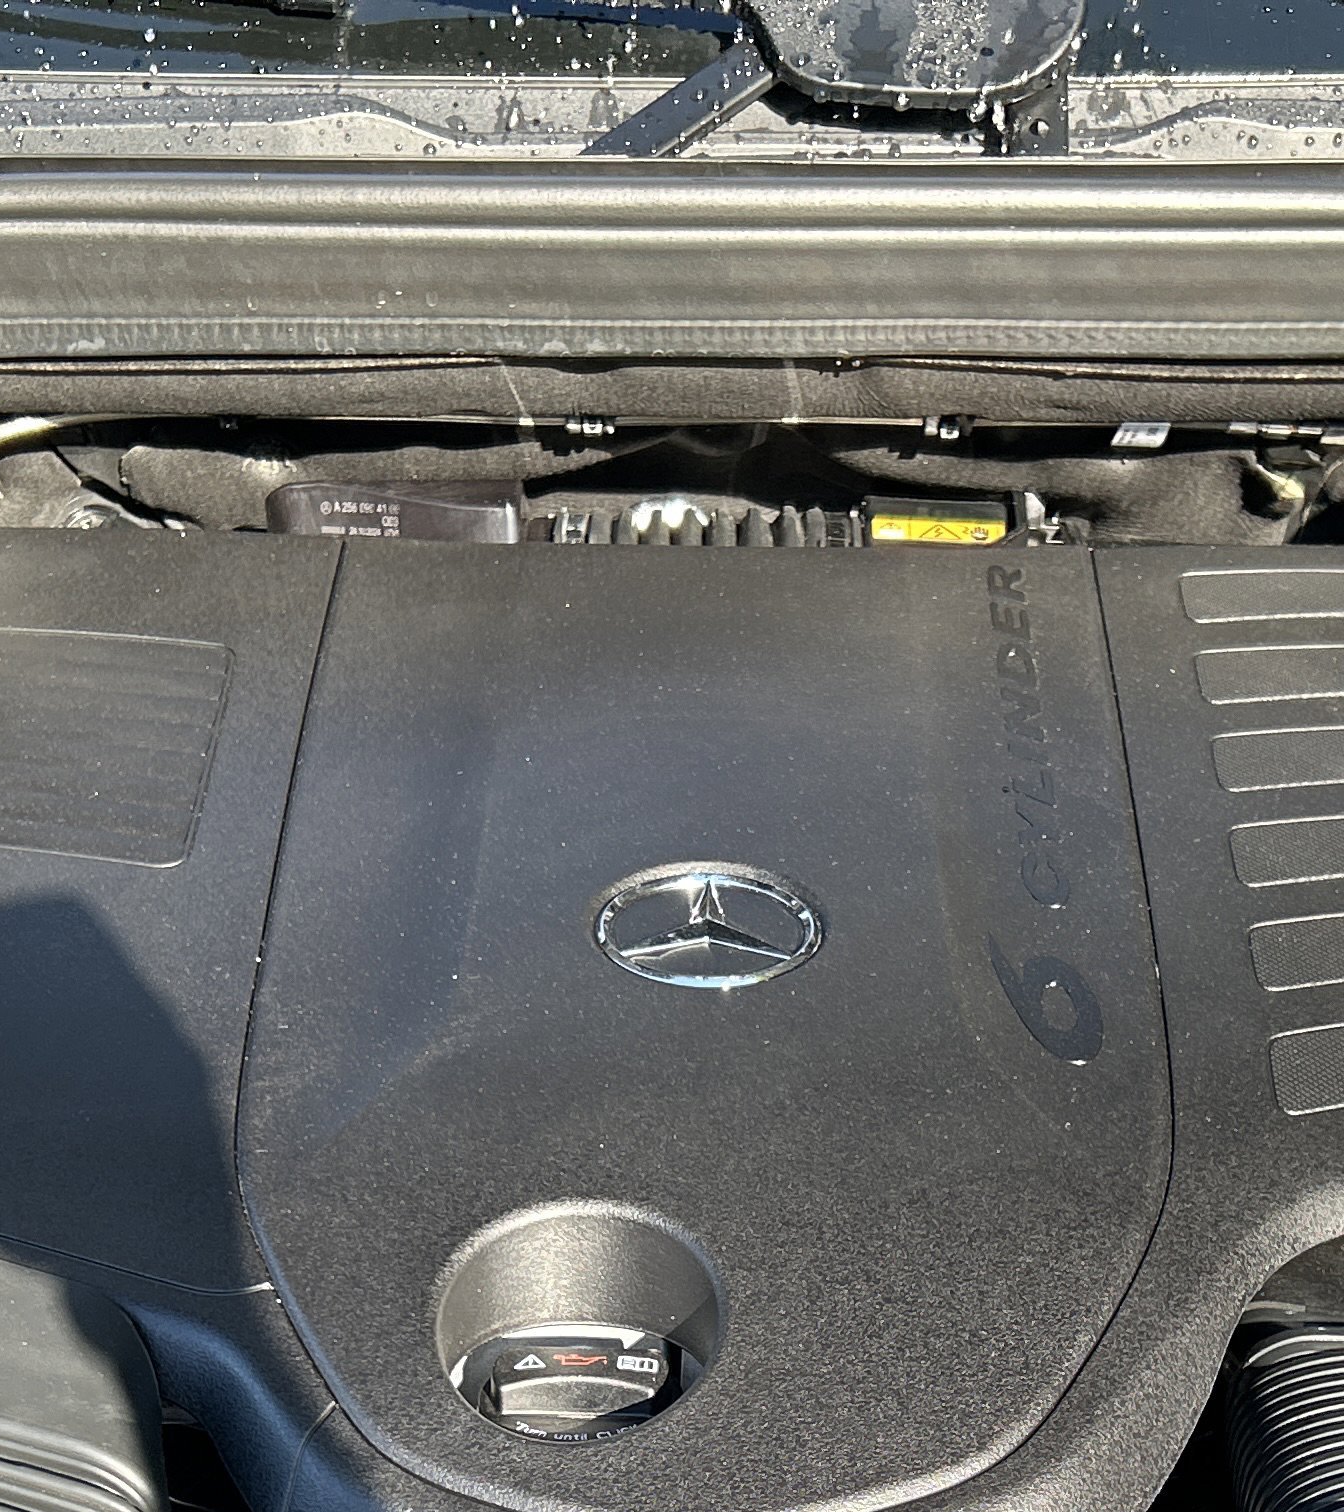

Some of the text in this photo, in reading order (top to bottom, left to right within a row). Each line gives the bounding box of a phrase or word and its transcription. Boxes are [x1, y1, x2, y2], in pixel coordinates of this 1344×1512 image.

[987, 563, 1105, 1066] 6 CYLINDER
[514, 1420, 548, 1438] Turn
[553, 1432, 588, 1442] until
